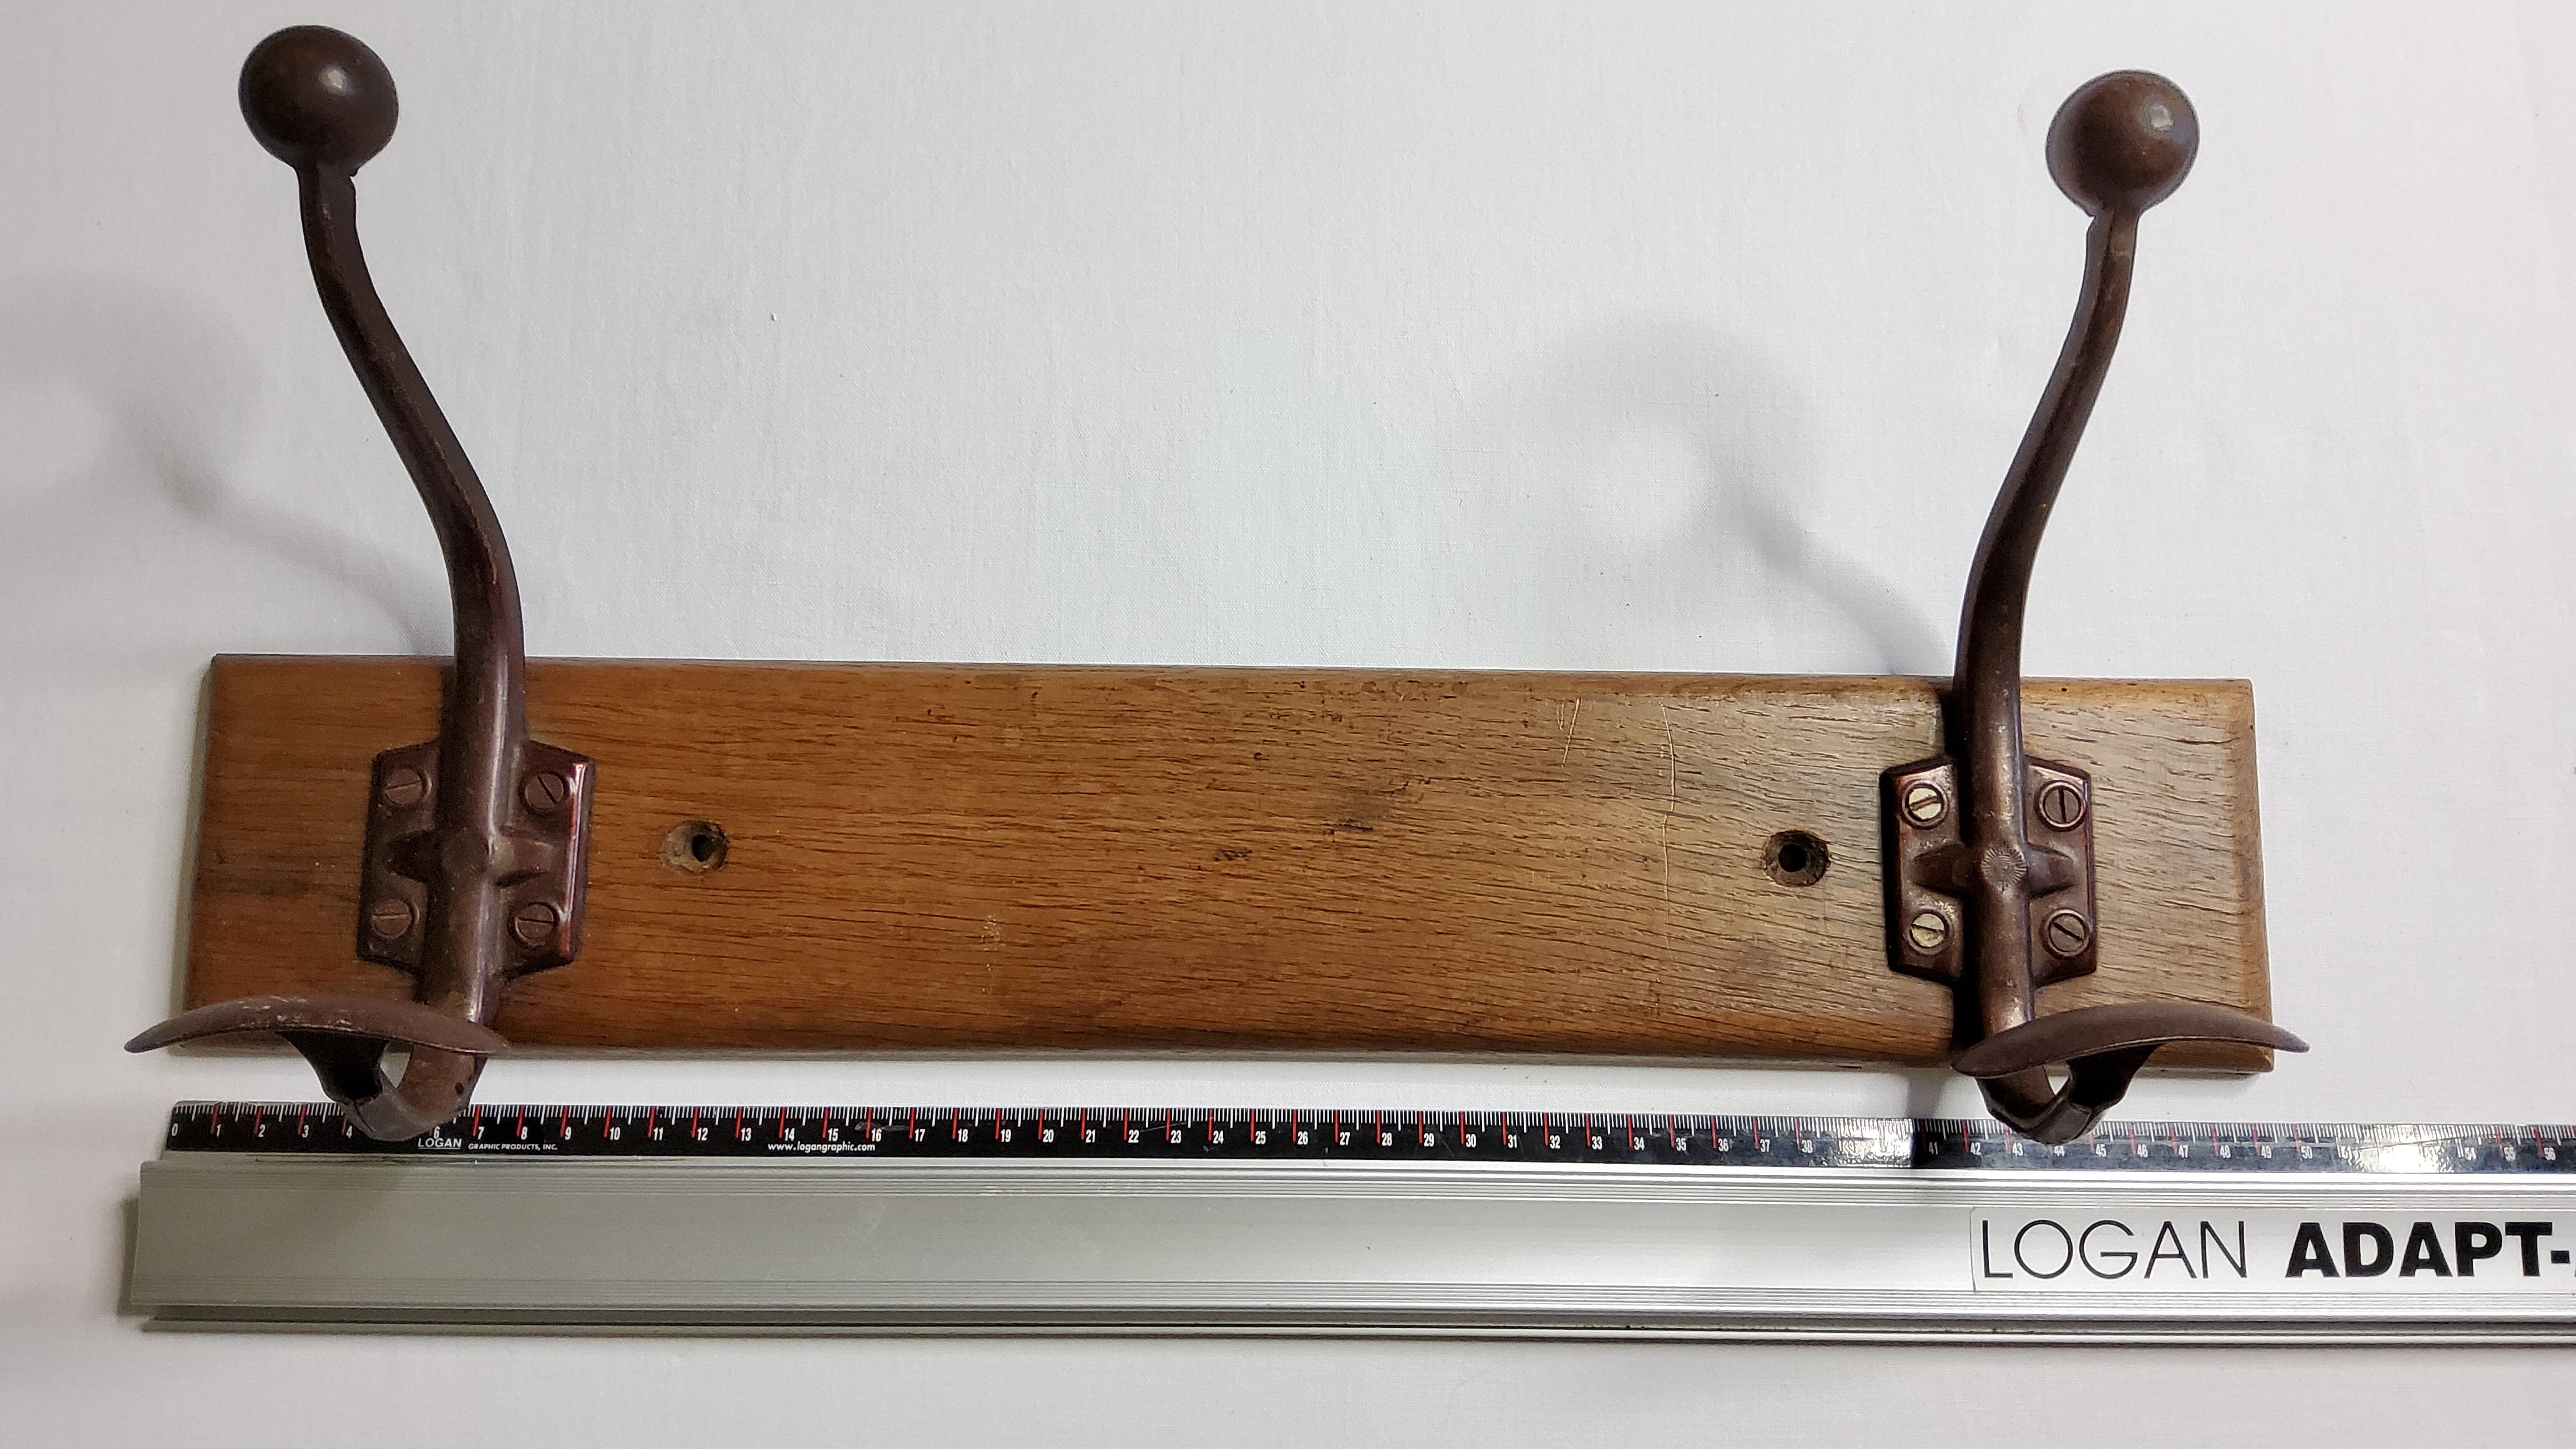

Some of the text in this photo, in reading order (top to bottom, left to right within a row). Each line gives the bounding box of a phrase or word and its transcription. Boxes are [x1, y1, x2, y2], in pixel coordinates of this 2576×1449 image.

[171, 1125, 178, 1136] 0
[217, 1124, 222, 1136] 1
[258, 1124, 266, 1138] 2
[302, 1125, 310, 1138] 3
[346, 1125, 353, 1138] 4
[432, 1125, 441, 1139] 6
[477, 1126, 485, 1140] 7
[520, 1126, 528, 1140] 8
[564, 1126, 572, 1141] 9
[610, 1126, 621, 1141] 10
[653, 1127, 663, 1141] 11
[697, 1127, 708, 1141] 12
[741, 1127, 752, 1141] 13
[784, 1128, 795, 1141] 14
[827, 1128, 839, 1142] 15
[871, 1128, 883, 1142] 16
[914, 1128, 925, 1142] 17
[957, 1128, 968, 1143] 18
[1000, 1128, 1012, 1143] 19
[1042, 1129, 1055, 1143] 20
[1085, 1129, 1096, 1143] 21
[1128, 1129, 1139, 1143] 22
[1170, 1129, 1182, 1144] 23
[1212, 1130, 1224, 1144] 24
[1255, 1130, 1266, 1144] 25
[1297, 1131, 1309, 1145] 26
[1339, 1131, 1350, 1146] 27
[1382, 1132, 1393, 1146] 28
[1423, 1133, 1435, 1147] 29
[1465, 1133, 1476, 1148] 30
[1508, 1134, 1518, 1148] 31
[1549, 1134, 1561, 1149] 32
[1591, 1136, 1603, 1150] 33
[1634, 1136, 1645, 1151] 34
[1676, 1137, 1687, 1151] 35
[1717, 1138, 1729, 1152] 36
[1760, 1138, 1770, 1153] 37
[1801, 1139, 1813, 1154] 38
[1929, 1141, 1938, 1155] 41
[1970, 1141, 1982, 1156] 42
[2012, 1142, 2024, 1156] 43
[2053, 1143, 2066, 1157] 44
[2095, 1143, 2107, 1158] 45
[2137, 1143, 2149, 1158] 46
[2178, 1143, 2189, 1158] 47
[2220, 1144, 2232, 1159] 48
[2261, 1144, 2273, 1159] 49
[2301, 1145, 2315, 1159] 50
[417, 1138, 462, 1148] LOGAN
[500, 1143, 541, 1151] PRODUCTS,
[768, 1141, 876, 1153] www.logangraphic.com
[1981, 1219, 2576, 1280] LOGAN ADAPT-
